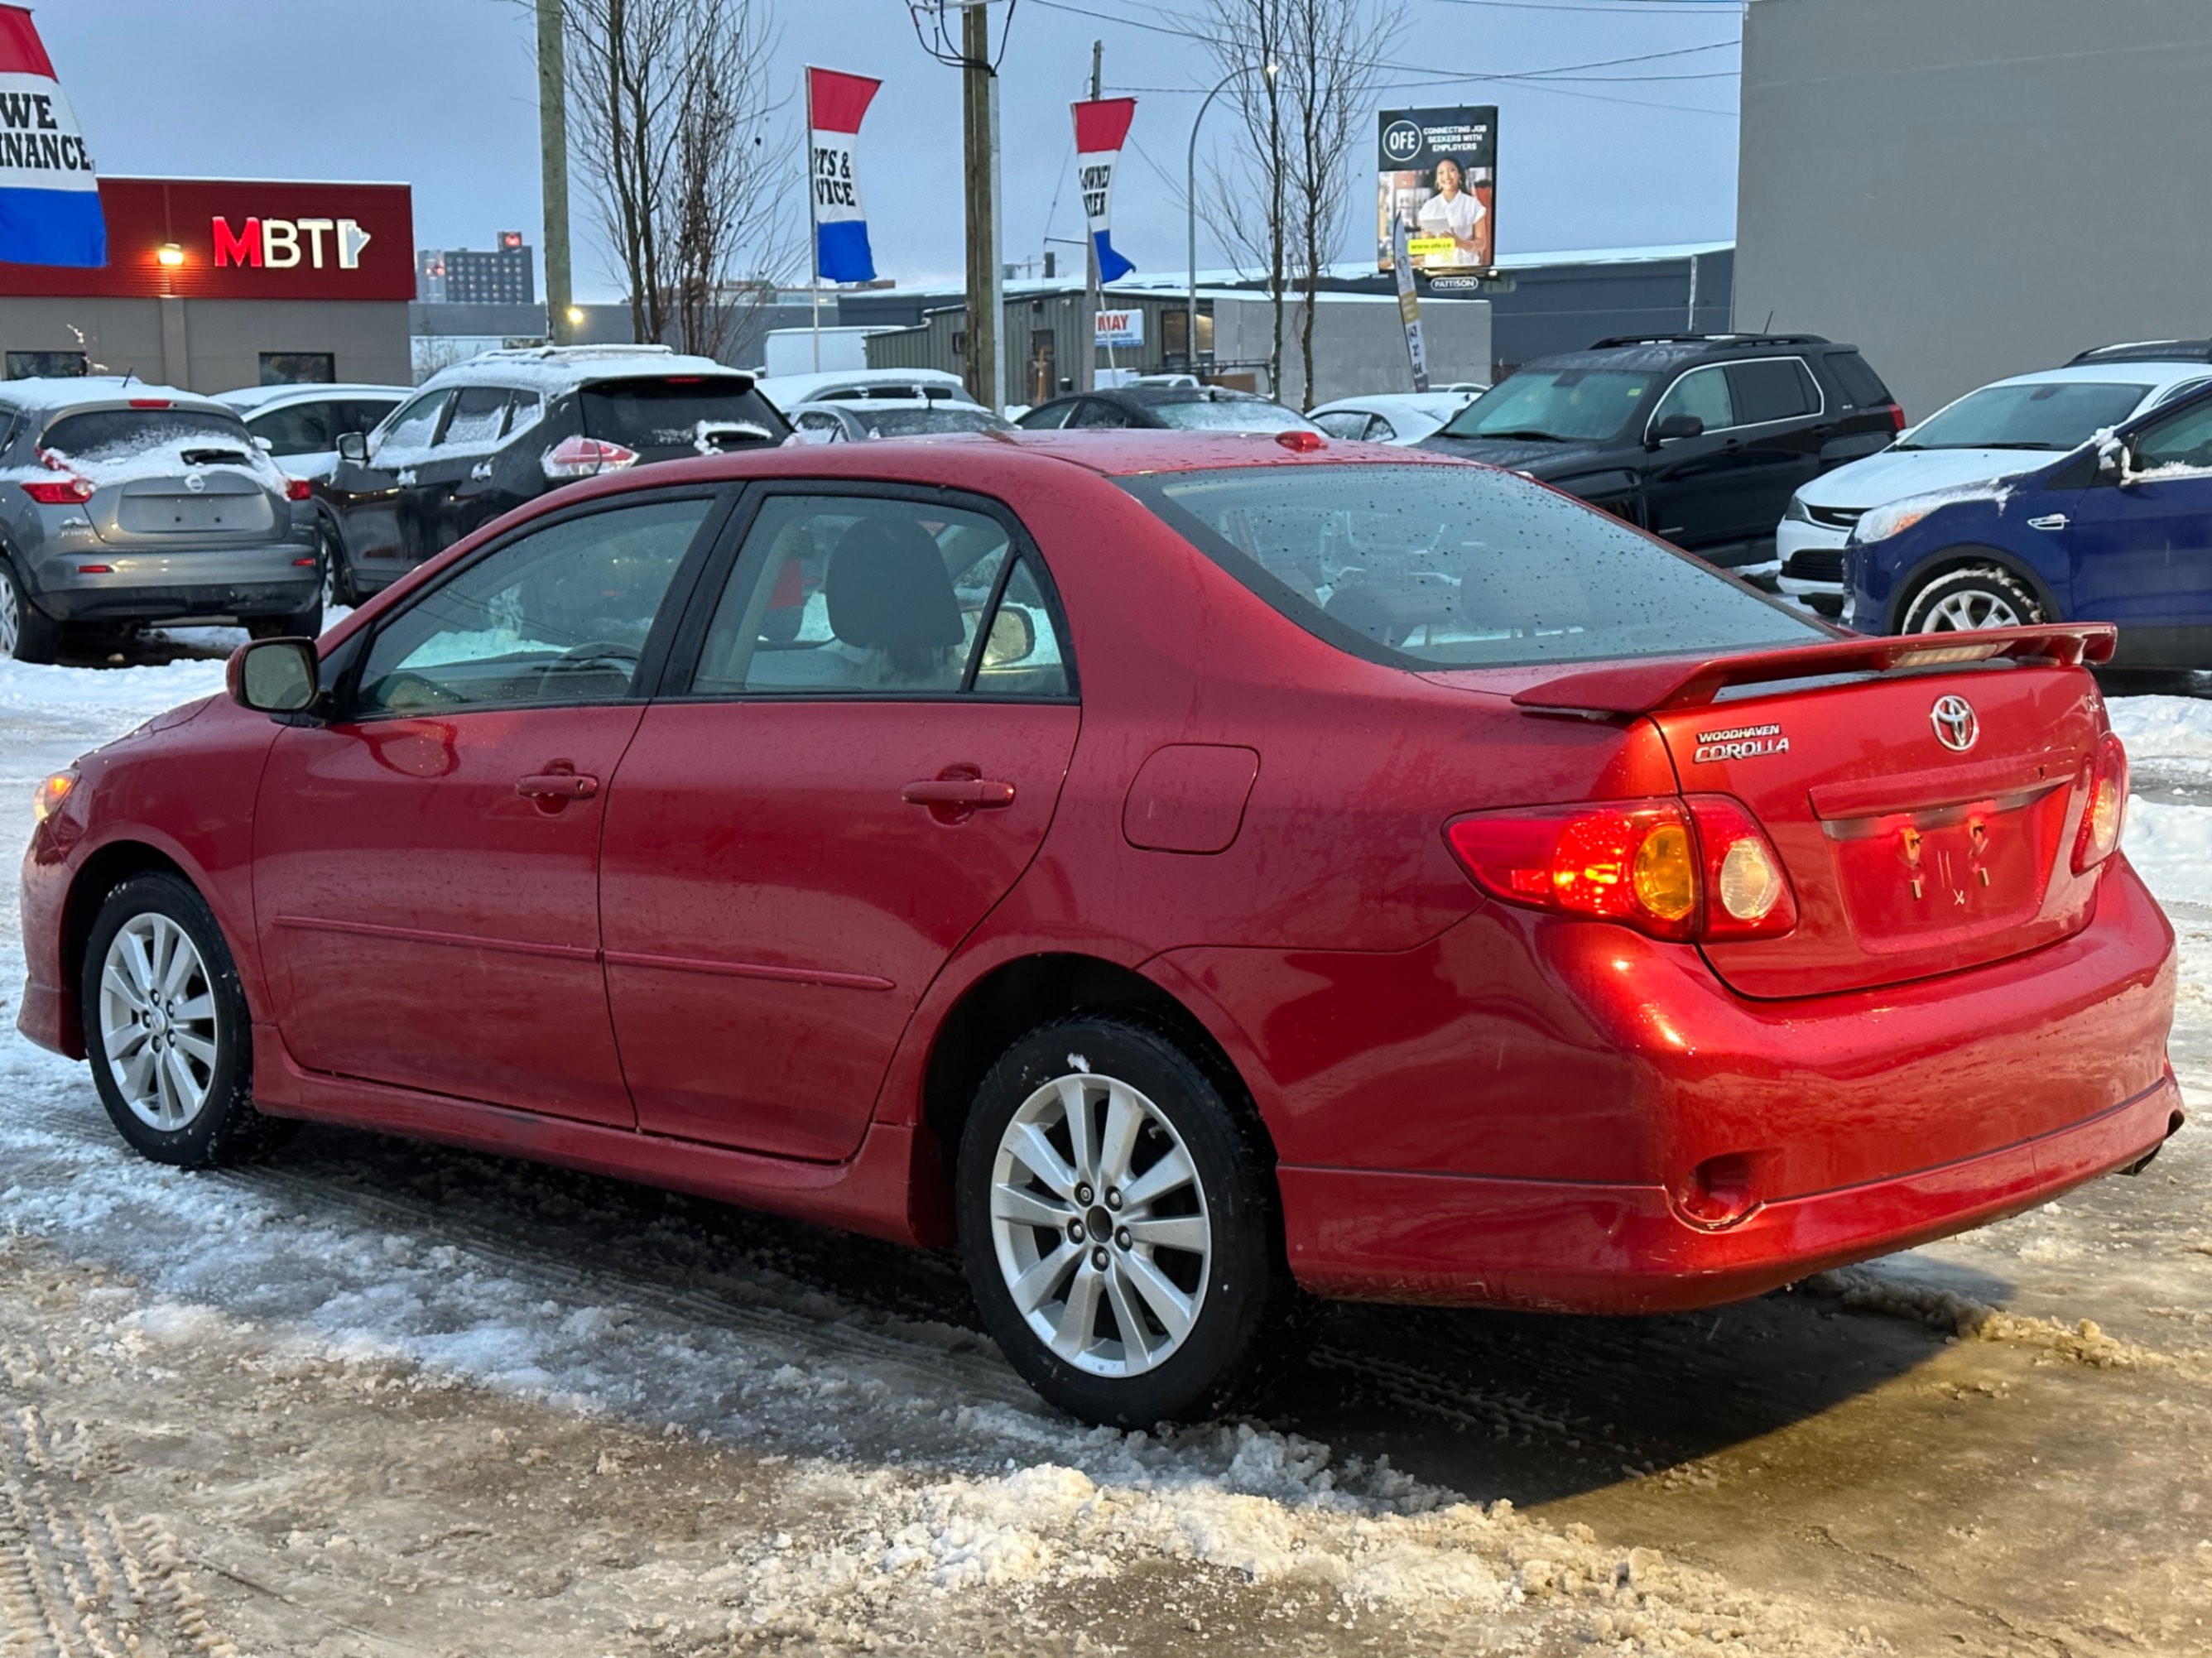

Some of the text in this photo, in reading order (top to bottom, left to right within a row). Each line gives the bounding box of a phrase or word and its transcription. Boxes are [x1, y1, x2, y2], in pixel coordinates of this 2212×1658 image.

[0, 92, 58, 130] WE
[1423, 124, 1488, 136] CONNECTING JOB
[1427, 133, 1483, 144] SEEKERS WITH
[1390, 131, 1416, 151] OFE
[1432, 142, 1478, 153] EMPLOYERS
[816, 177, 856, 207] VICE
[1434, 279, 1475, 289] PATTISON
[1698, 724, 1781, 743] WOODHAVEN
[1694, 737, 1790, 763] COROLLA
